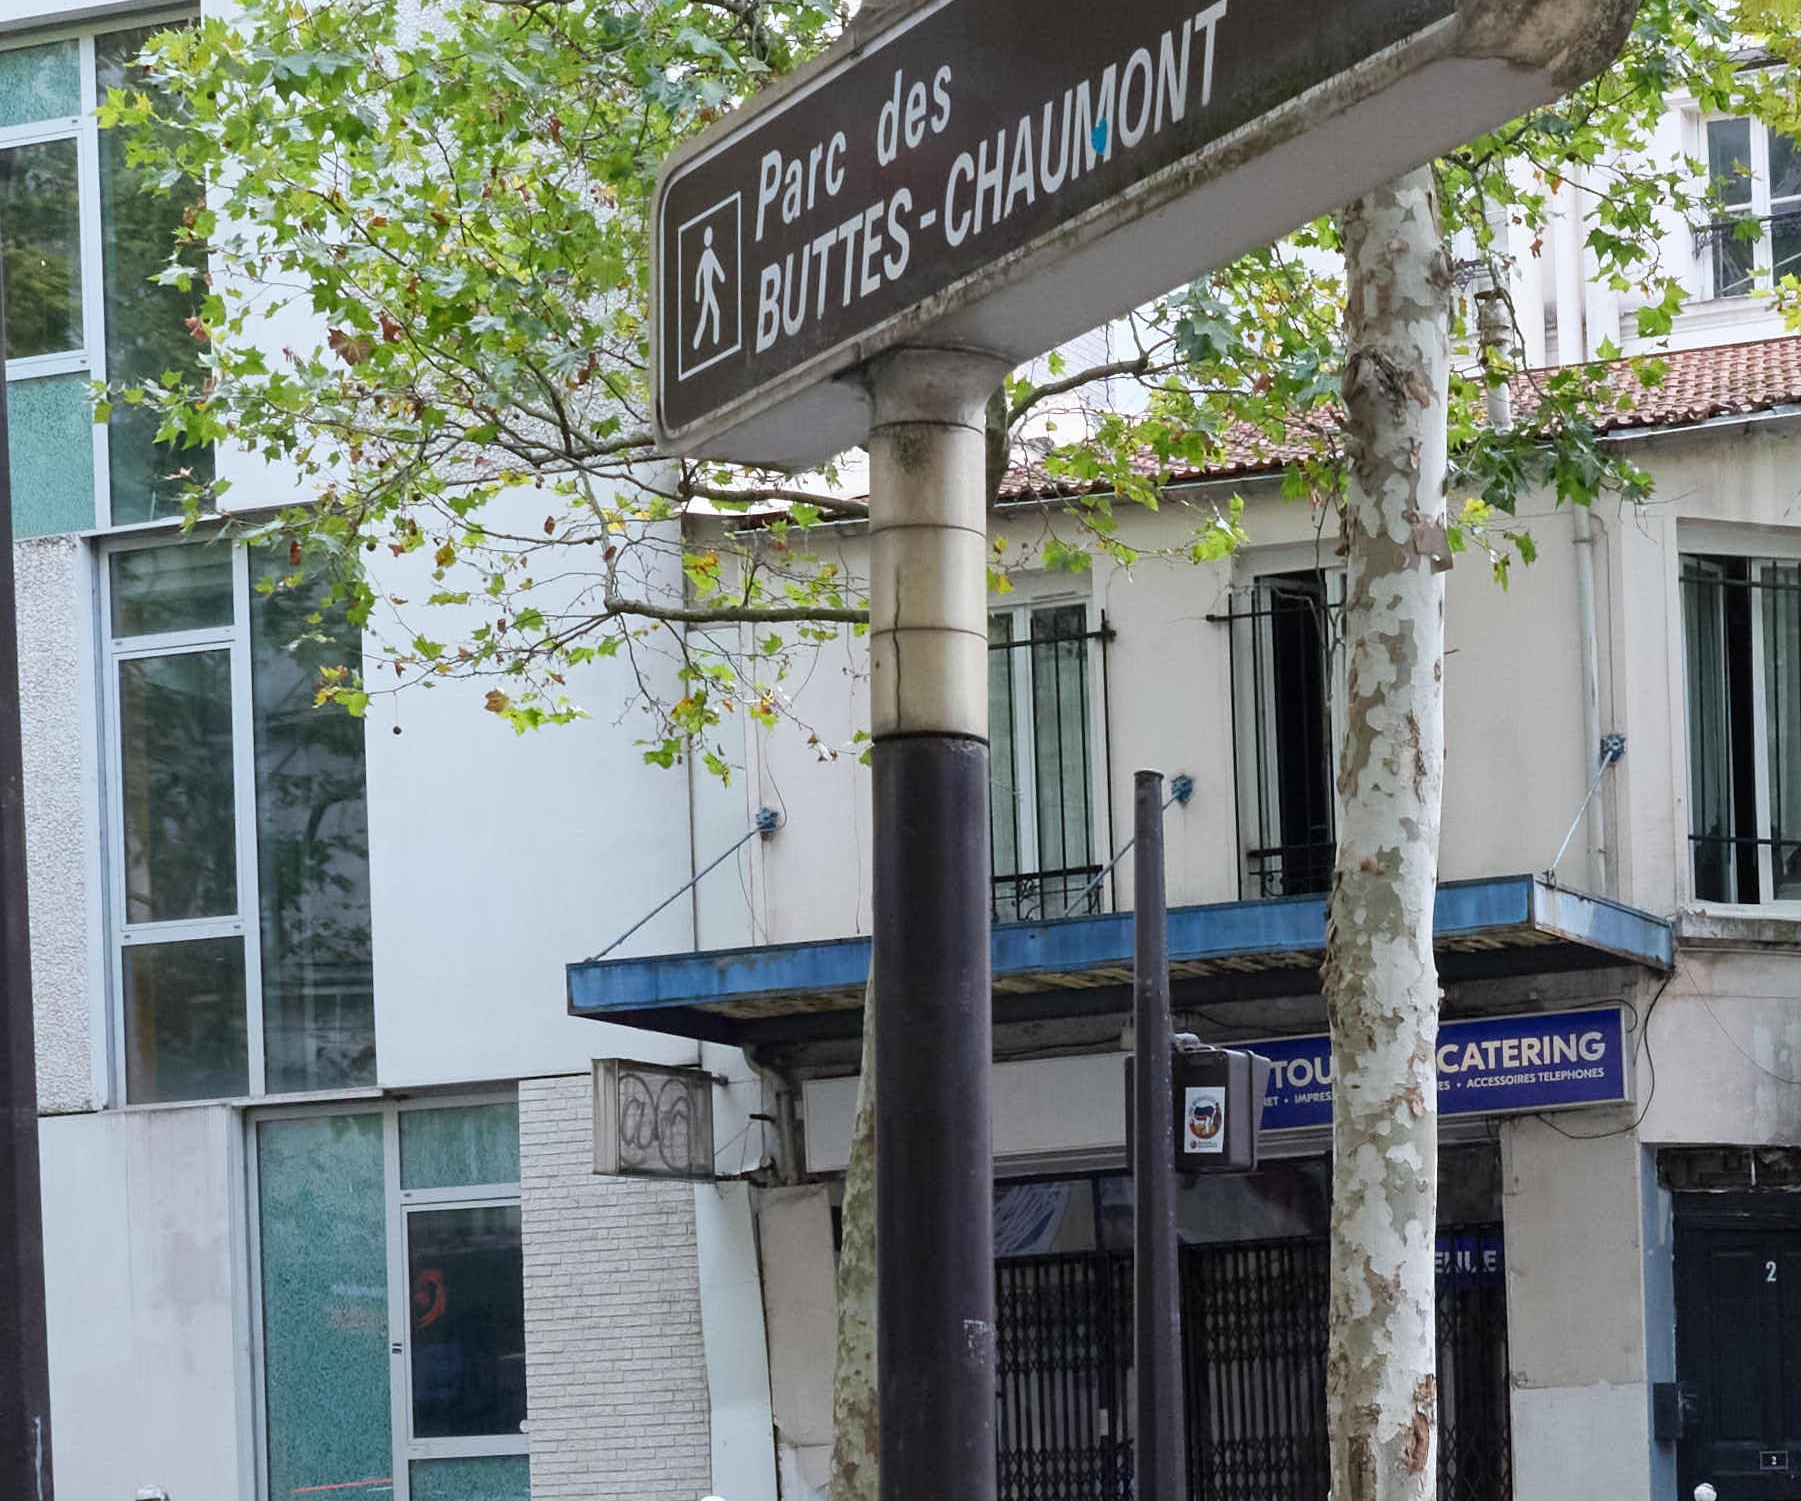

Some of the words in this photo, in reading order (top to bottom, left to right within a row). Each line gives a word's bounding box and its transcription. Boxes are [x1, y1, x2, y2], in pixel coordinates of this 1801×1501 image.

[755, 130, 848, 243] Parc
[876, 64, 953, 168] des
[1466, 1073, 1536, 1089] ACCESSOIRES
[1537, 1067, 1605, 1083] TELEPHONES
[1765, 1260, 1778, 1283] 2
